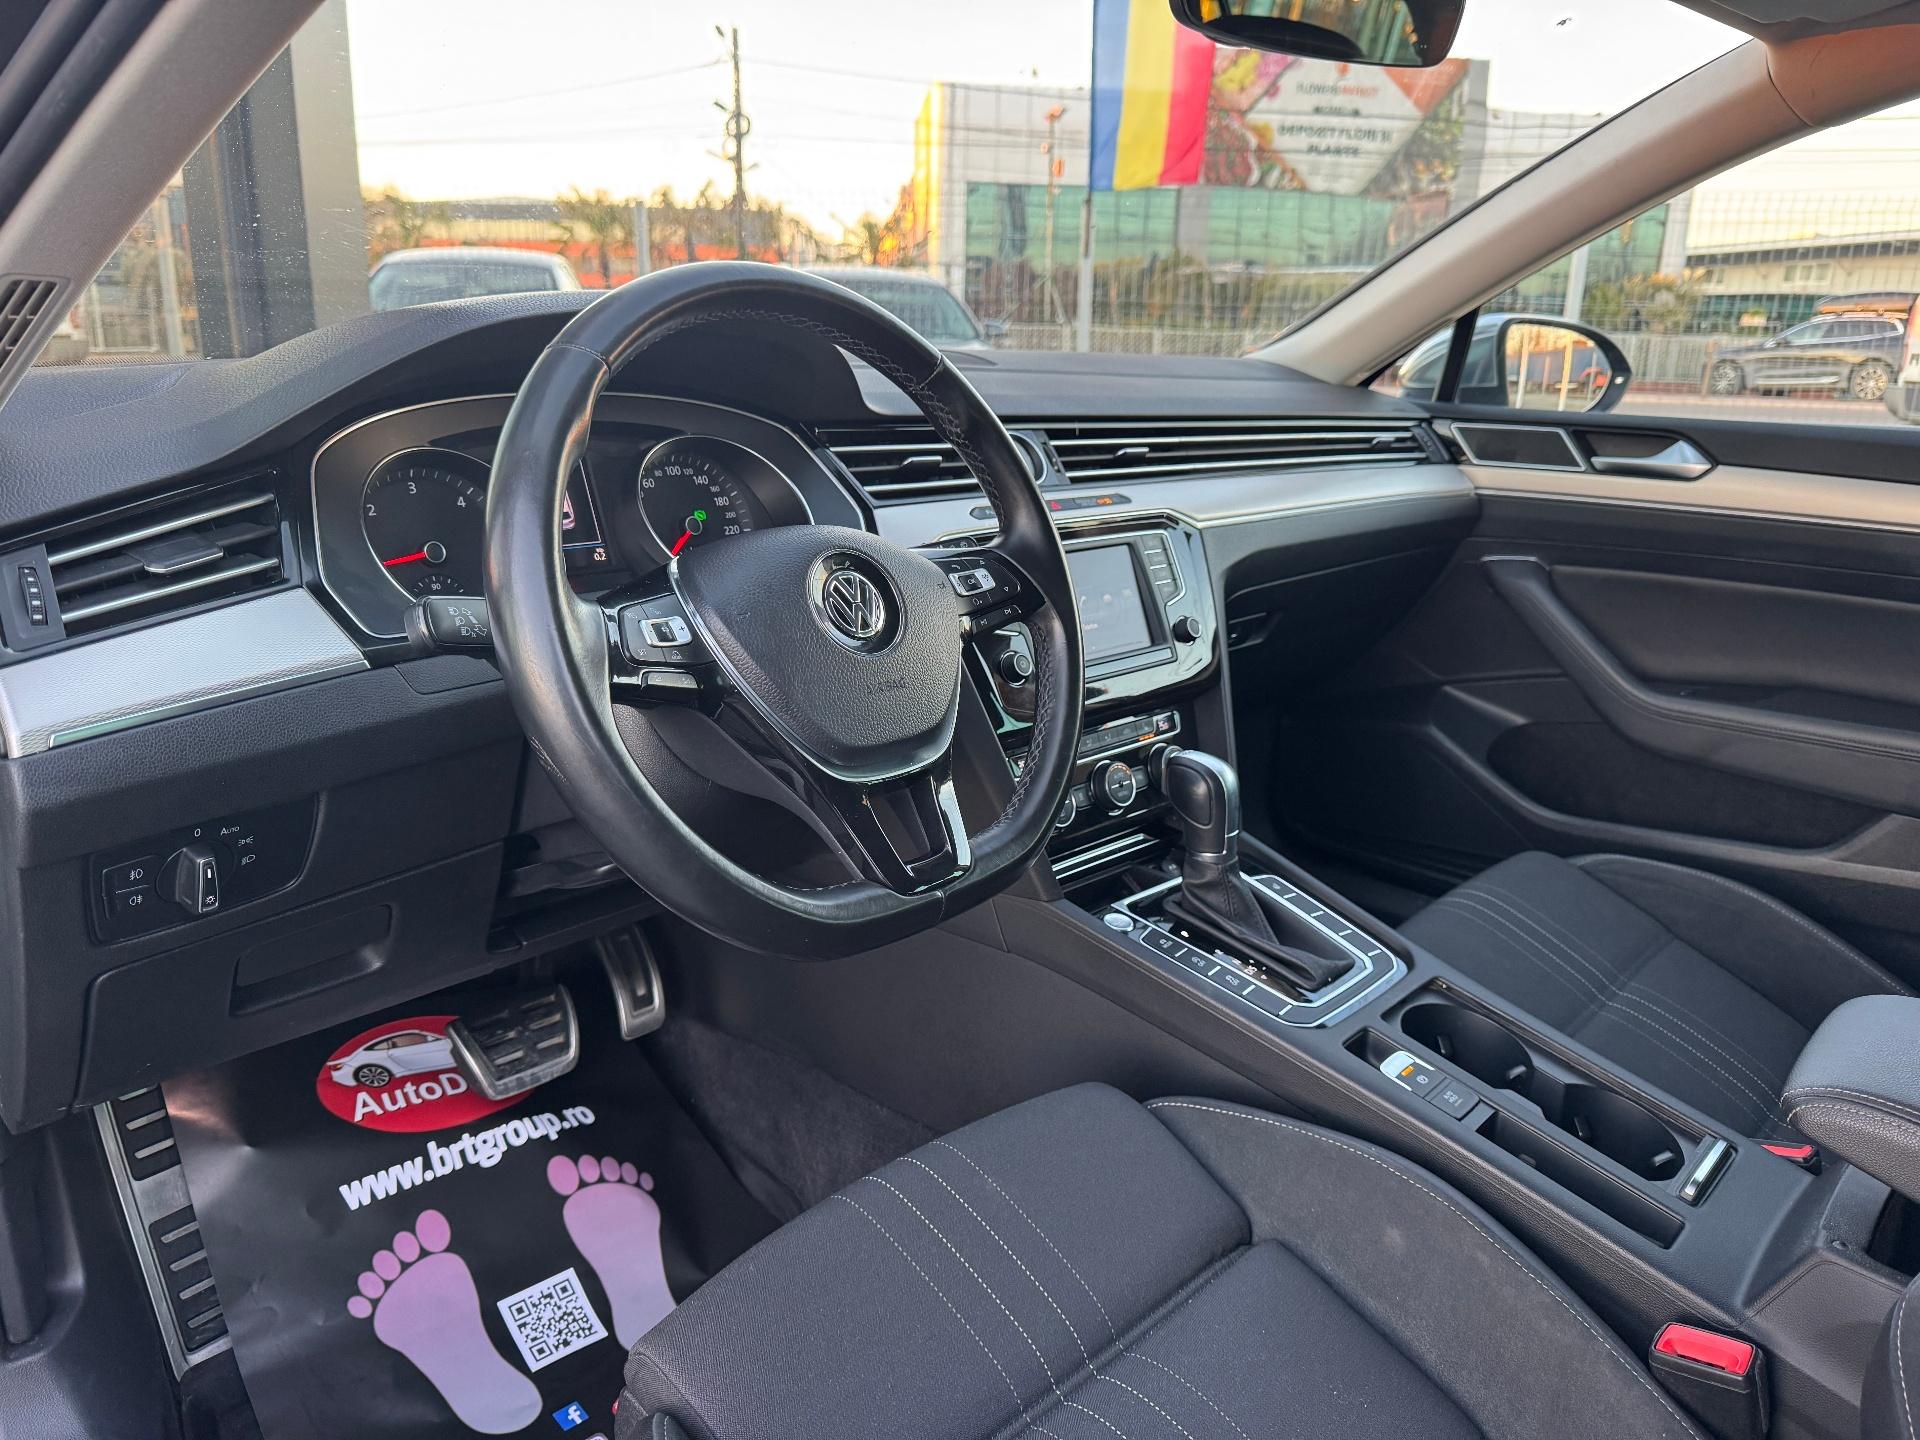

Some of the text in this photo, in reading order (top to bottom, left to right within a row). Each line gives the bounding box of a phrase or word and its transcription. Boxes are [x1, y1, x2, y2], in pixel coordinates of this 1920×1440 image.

[665, 466, 681, 476] 100
[642, 478, 655, 488] 60
[693, 475, 709, 485] 140
[407, 482, 417, 494] 3
[457, 496, 467, 508] 4
[714, 496, 729, 506] 180
[366, 503, 377, 516] 2
[723, 525, 740, 535] 220
[432, 582, 441, 591] 90
[338, 1105, 596, 1211] www.brtgroup.ro
